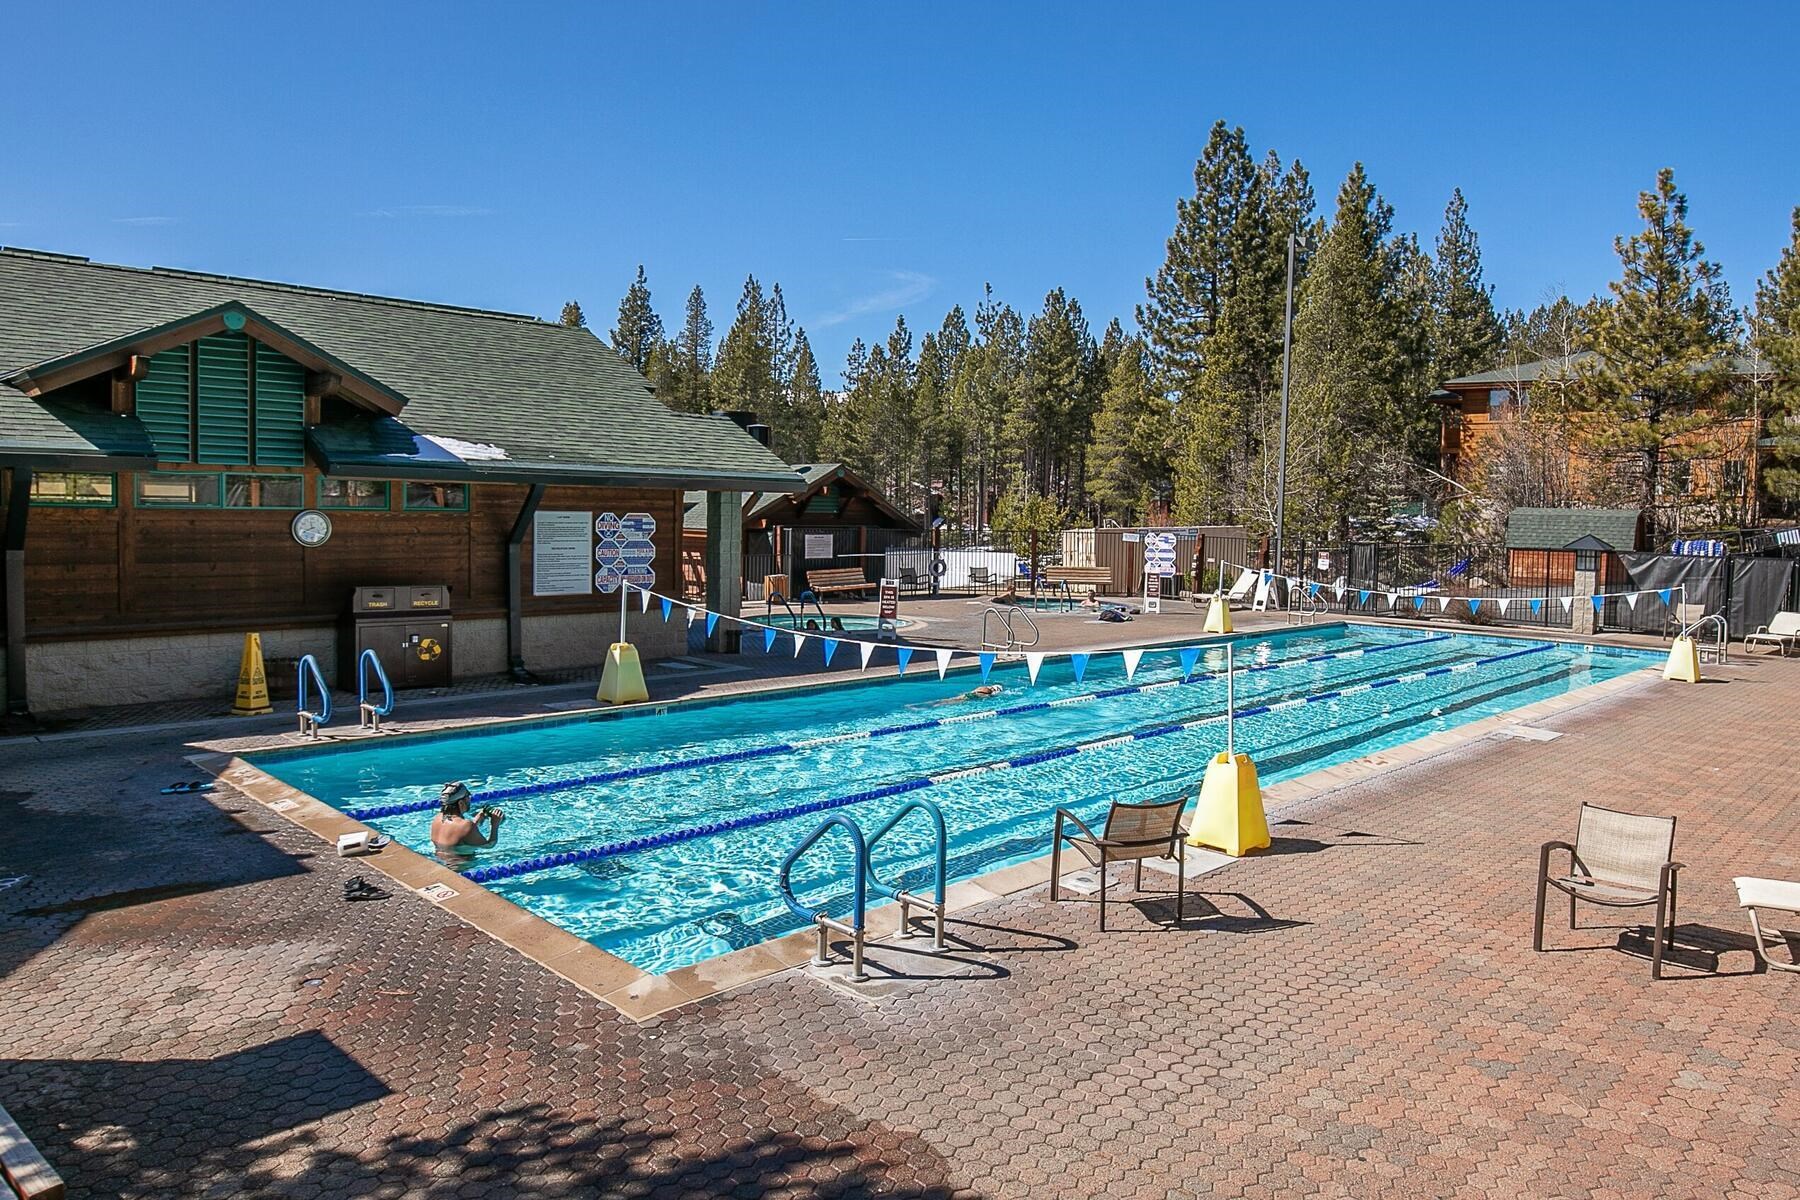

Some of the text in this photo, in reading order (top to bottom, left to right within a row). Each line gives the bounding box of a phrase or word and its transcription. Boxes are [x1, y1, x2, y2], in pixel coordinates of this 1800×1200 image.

[604, 514, 614, 522] NO
[597, 522, 620, 530] DIVING
[597, 549, 620, 557] CAUTION
[597, 576, 619, 584] CAPACITY
